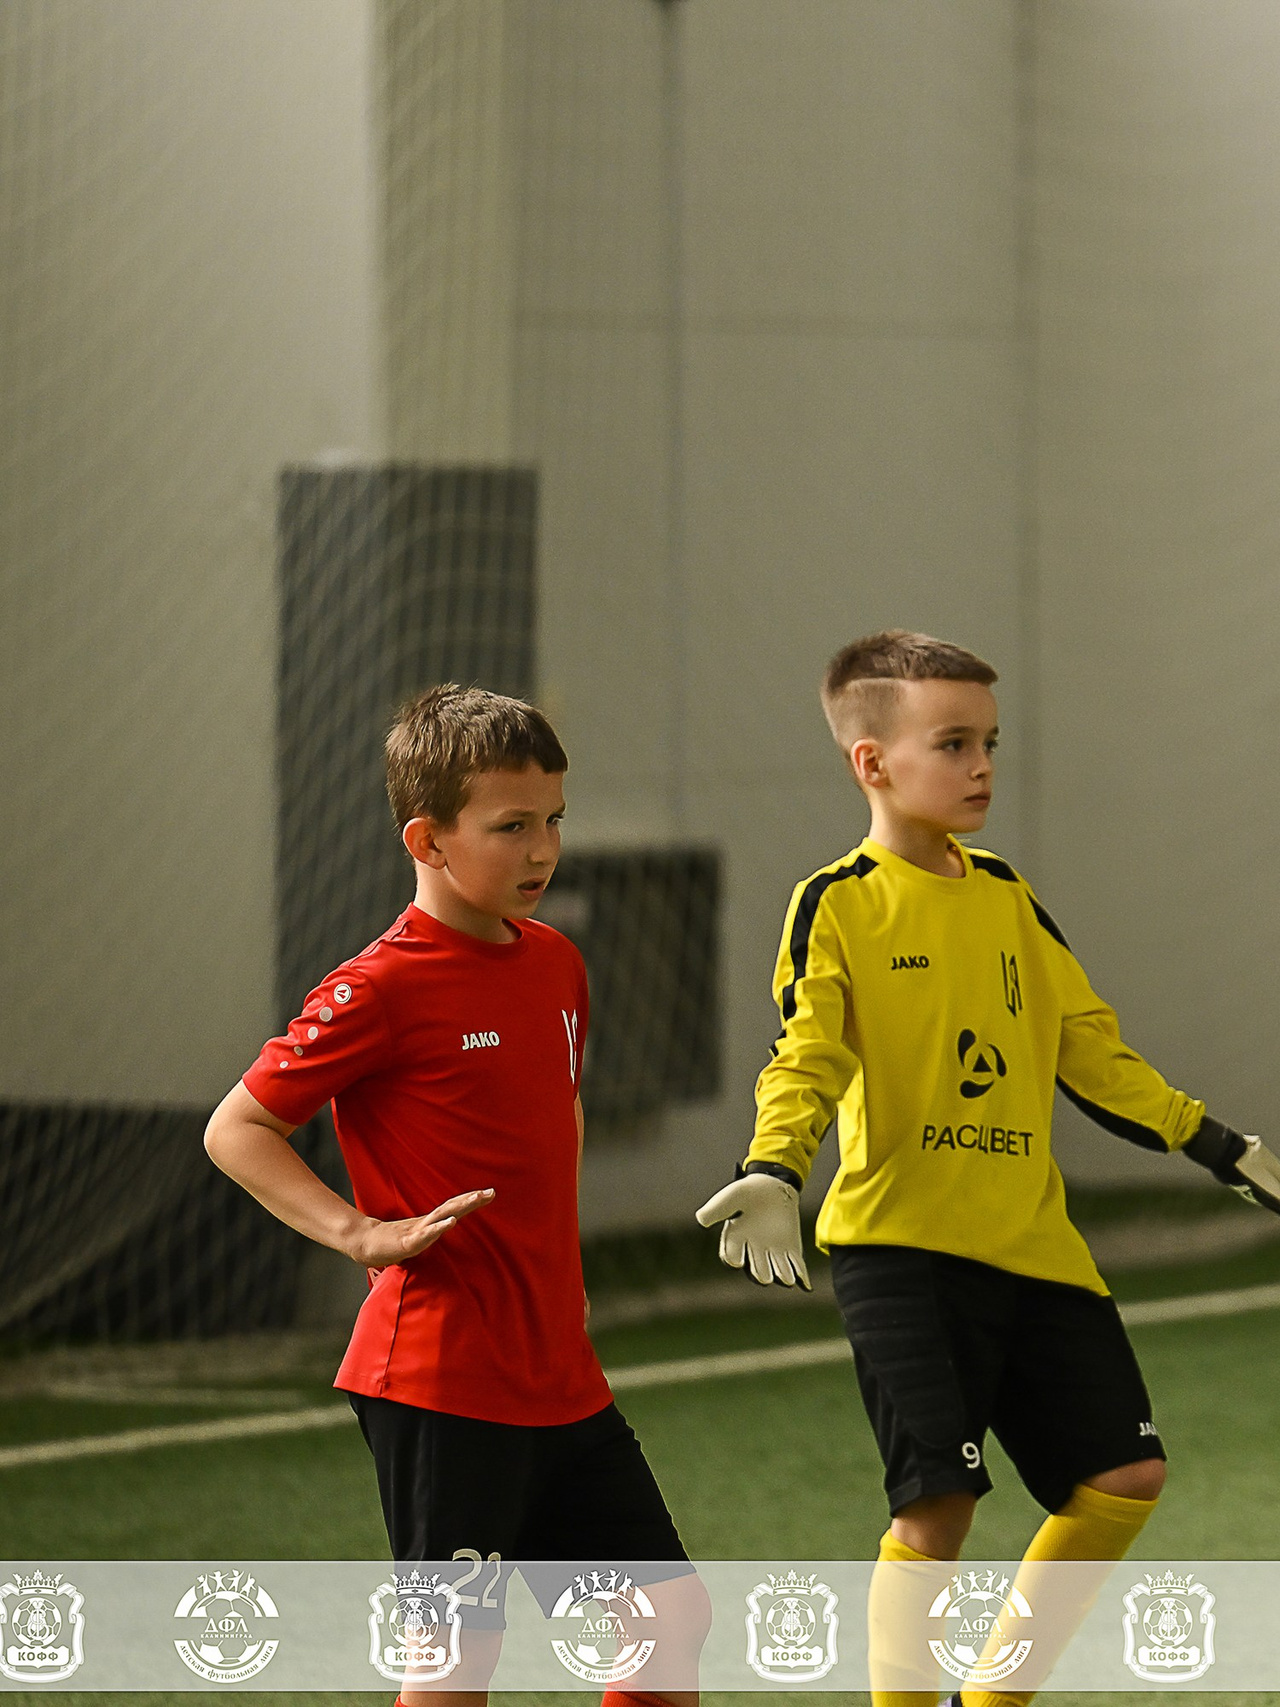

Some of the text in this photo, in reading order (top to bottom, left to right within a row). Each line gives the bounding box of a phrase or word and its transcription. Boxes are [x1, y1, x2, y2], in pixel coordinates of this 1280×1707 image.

[891, 955, 930, 970] JAKO
[462, 1031, 500, 1051] JAKO
[922, 1124, 1033, 1157] РАСЦВЕТ
[961, 1442, 981, 1469] 9
